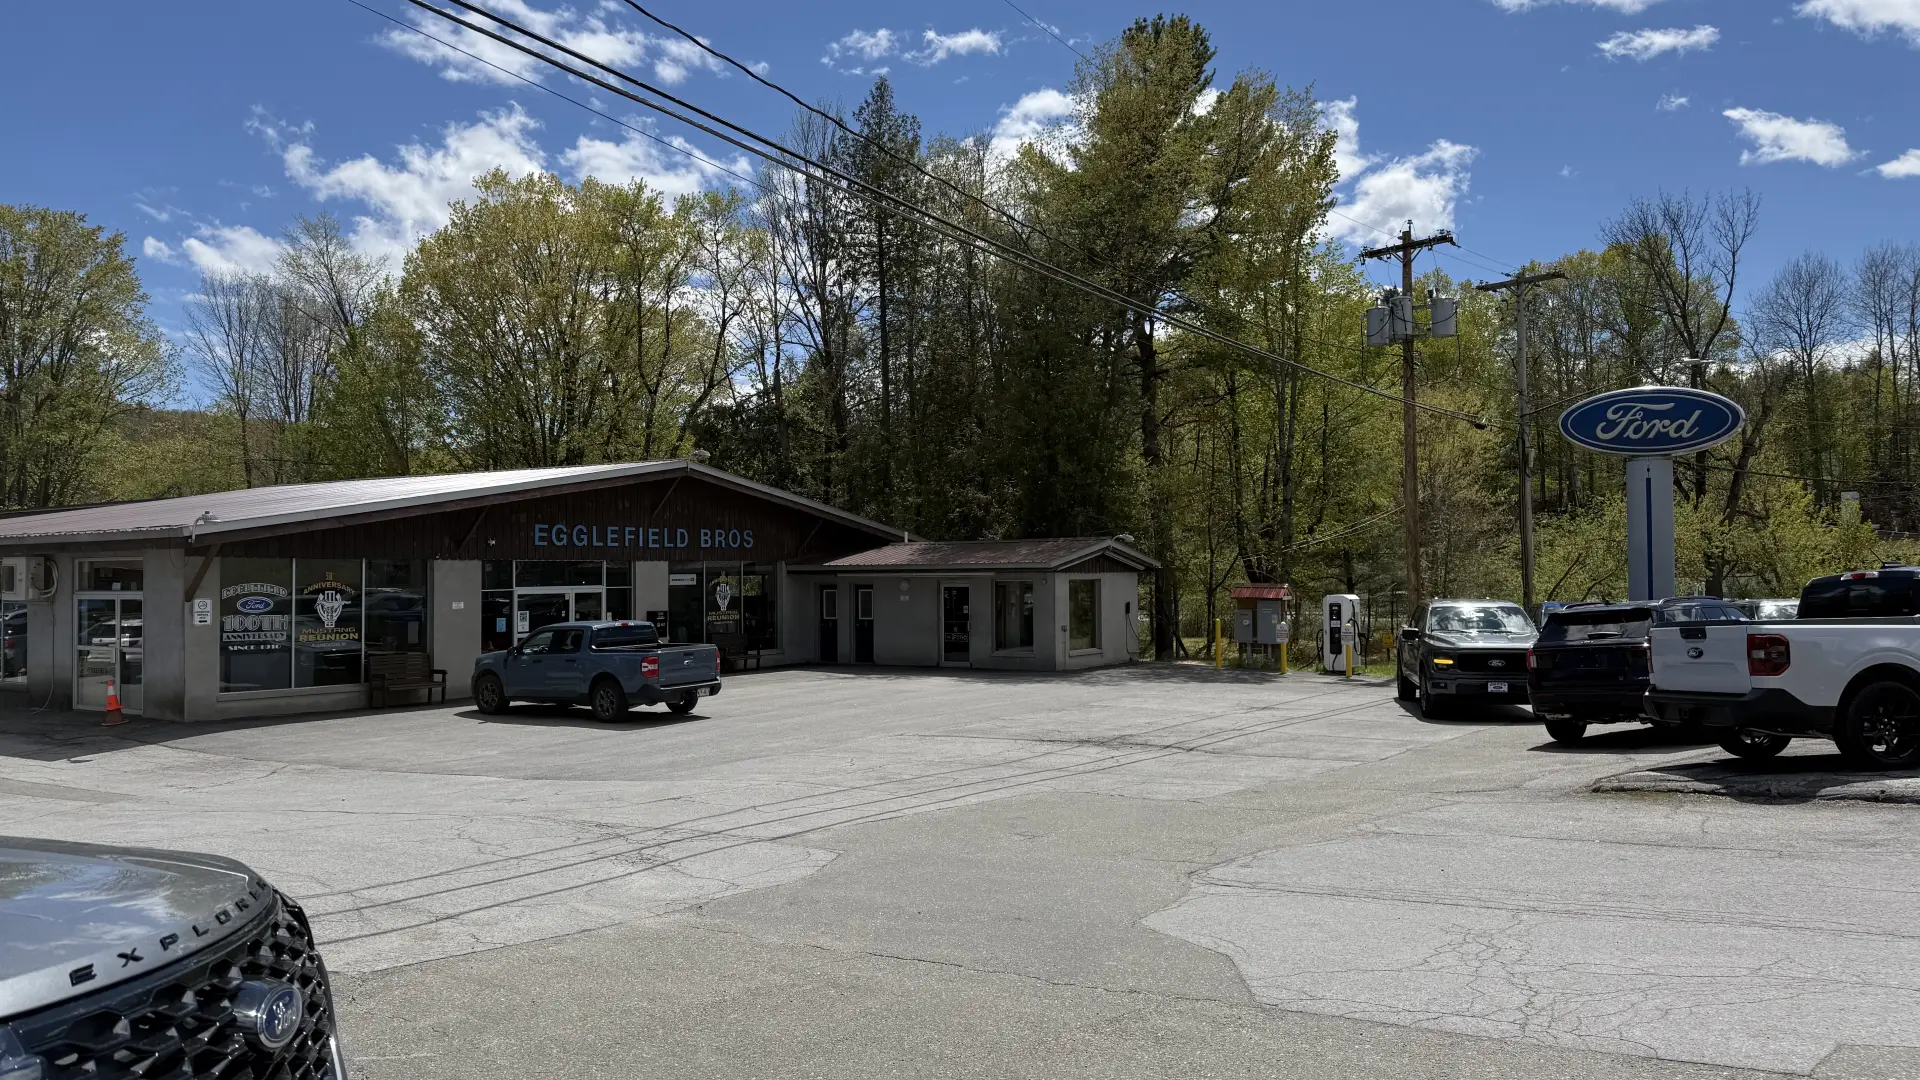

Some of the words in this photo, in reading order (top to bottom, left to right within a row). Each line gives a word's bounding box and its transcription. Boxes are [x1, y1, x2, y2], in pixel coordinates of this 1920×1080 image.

[1595, 402, 1703, 440] Ford
[534, 523, 689, 547] EGGLEFIELD
[700, 528, 754, 548] BROS
[303, 581, 356, 596] ANNIVERSARY
[222, 614, 289, 632] 100TH
[301, 626, 357, 634] MUSTANG
[223, 632, 287, 641] ANNIVERSARY
[299, 631, 359, 642] REUNION
[68, 879, 268, 987] EXPLORER
